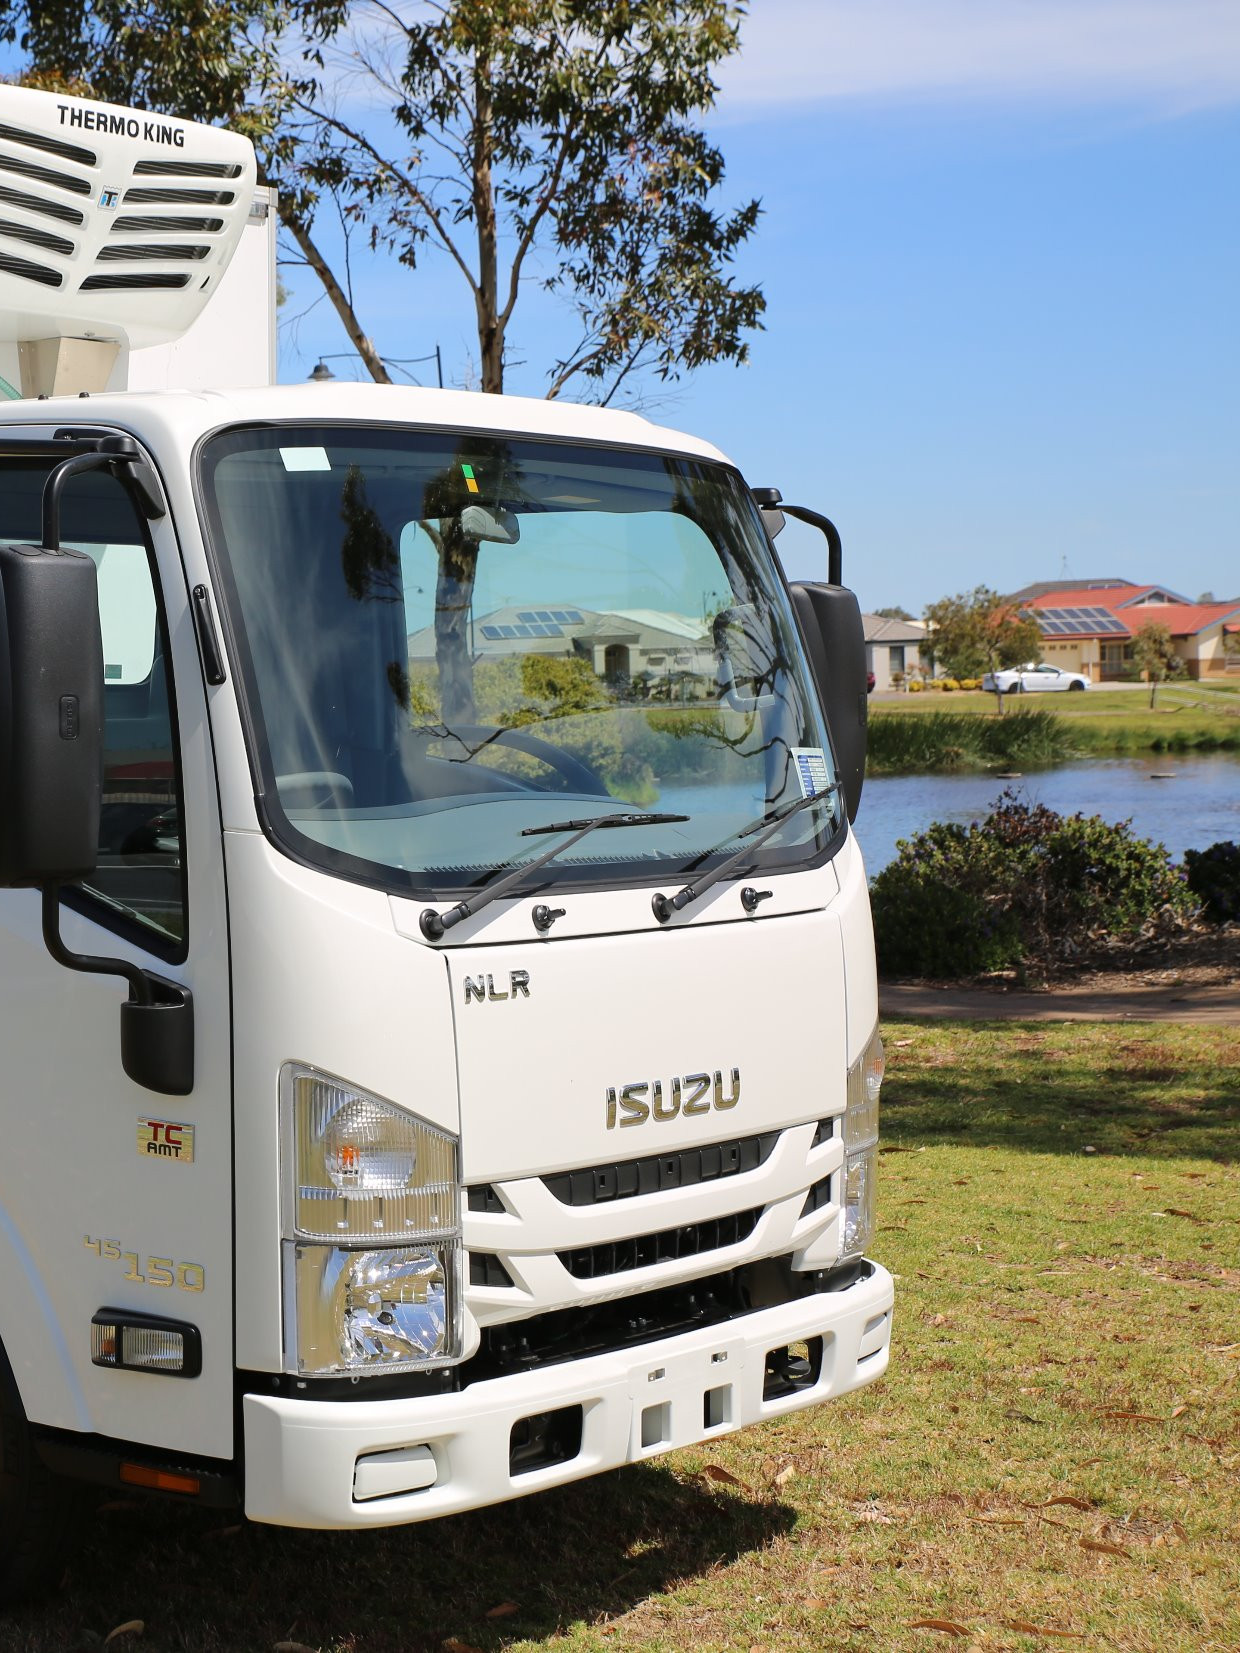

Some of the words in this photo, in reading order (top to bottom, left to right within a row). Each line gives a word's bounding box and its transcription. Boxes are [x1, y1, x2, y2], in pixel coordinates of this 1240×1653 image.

[57, 104, 140, 138] THERMO
[144, 121, 185, 148] KING
[463, 969, 532, 1005] NLR
[605, 1066, 741, 1131] ISUZU
[147, 1121, 183, 1146] TC
[147, 1141, 182, 1158] AMT
[83, 1234, 122, 1261] 45
[123, 1251, 205, 1293] 150
